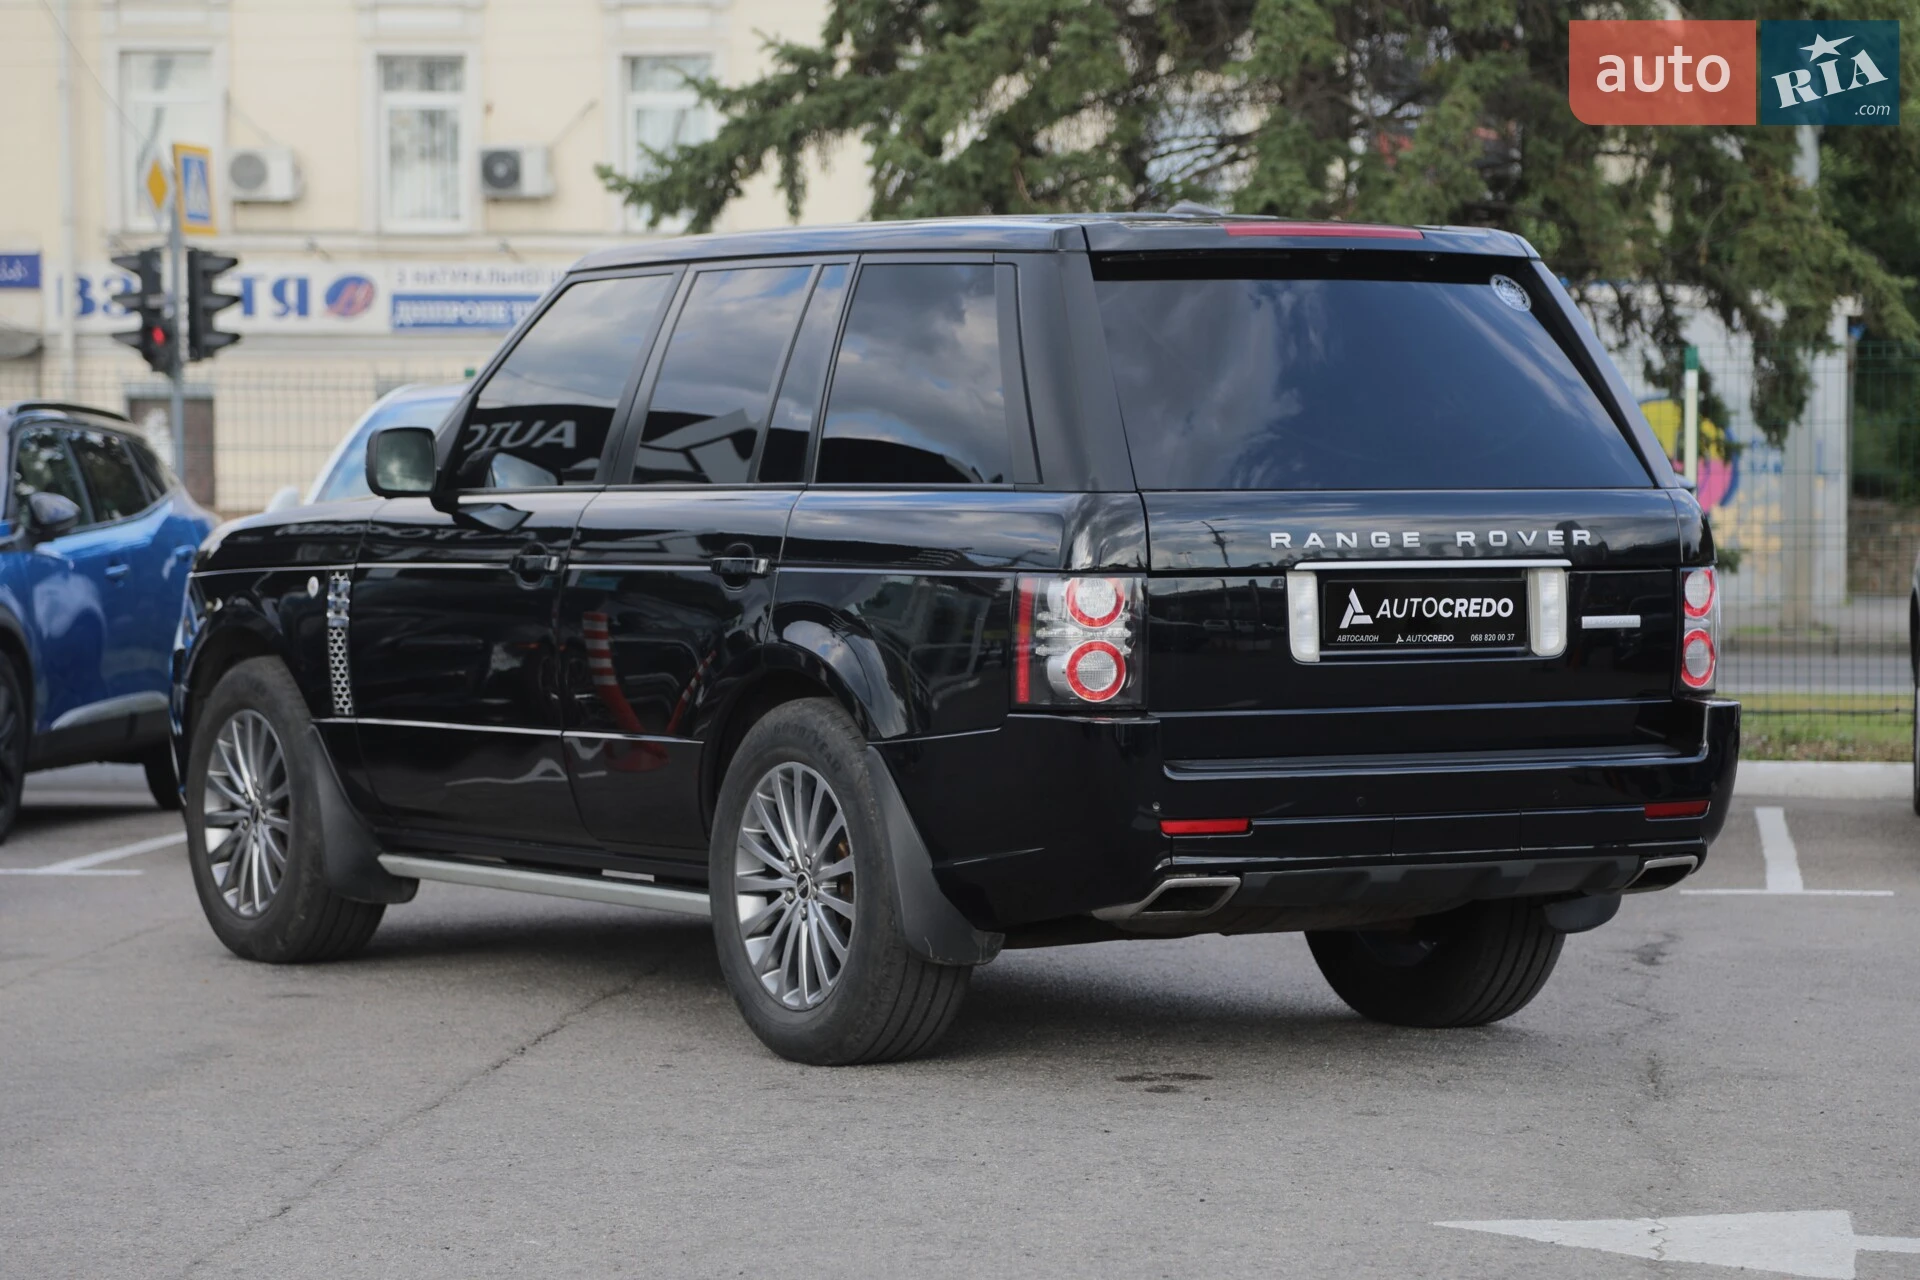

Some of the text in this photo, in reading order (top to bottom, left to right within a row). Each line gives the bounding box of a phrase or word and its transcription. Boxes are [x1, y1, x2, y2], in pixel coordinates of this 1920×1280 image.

[57, 276, 311, 316] ВЗТЯ
[1270, 530, 1592, 548] RANGE ROVER
[1376, 597, 1514, 619] AUTOCREDO
[1336, 634, 1379, 643] АВТОСАЛОН
[1405, 634, 1454, 643] AUTOCREDO
[1470, 633, 1515, 642] 068 820 00 37
